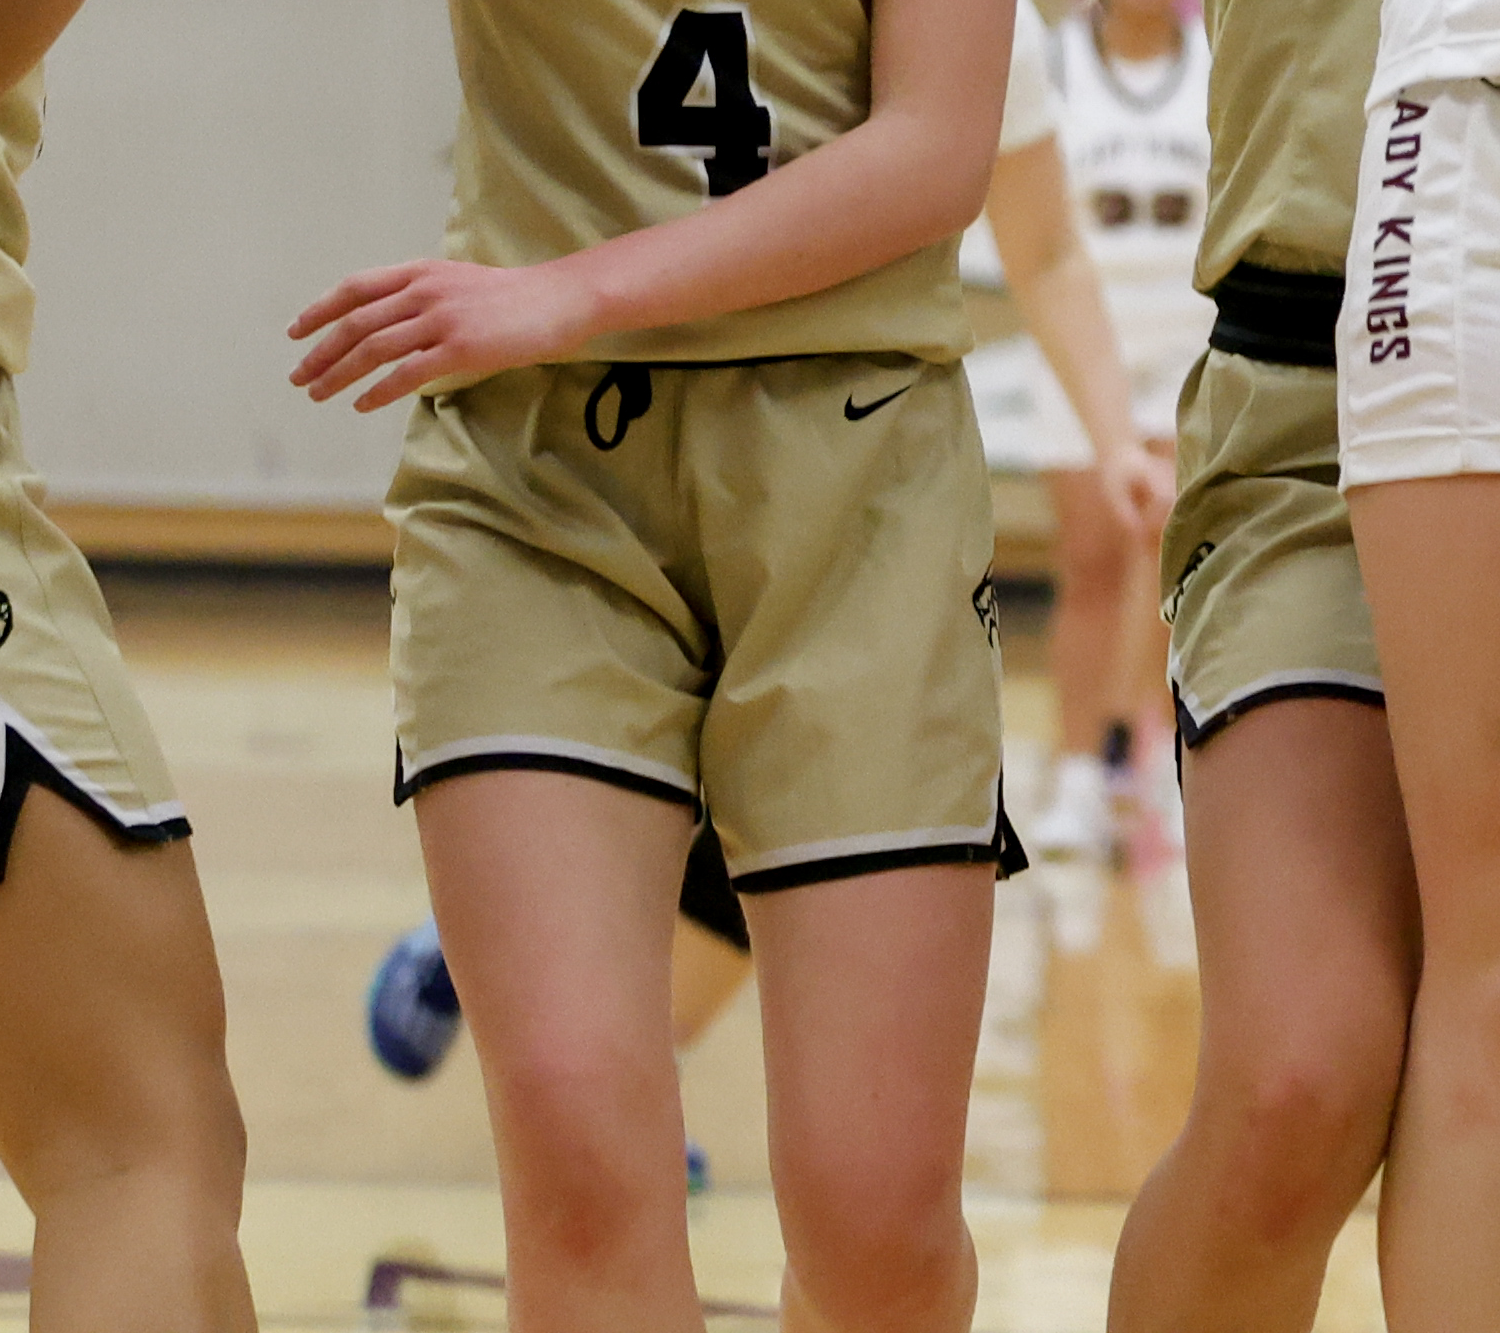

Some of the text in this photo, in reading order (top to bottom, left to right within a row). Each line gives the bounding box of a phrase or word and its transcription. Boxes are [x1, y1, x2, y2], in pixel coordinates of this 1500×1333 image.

[635, 3, 774, 200] 4
[1366, 88, 1429, 365] ADY KINGS
